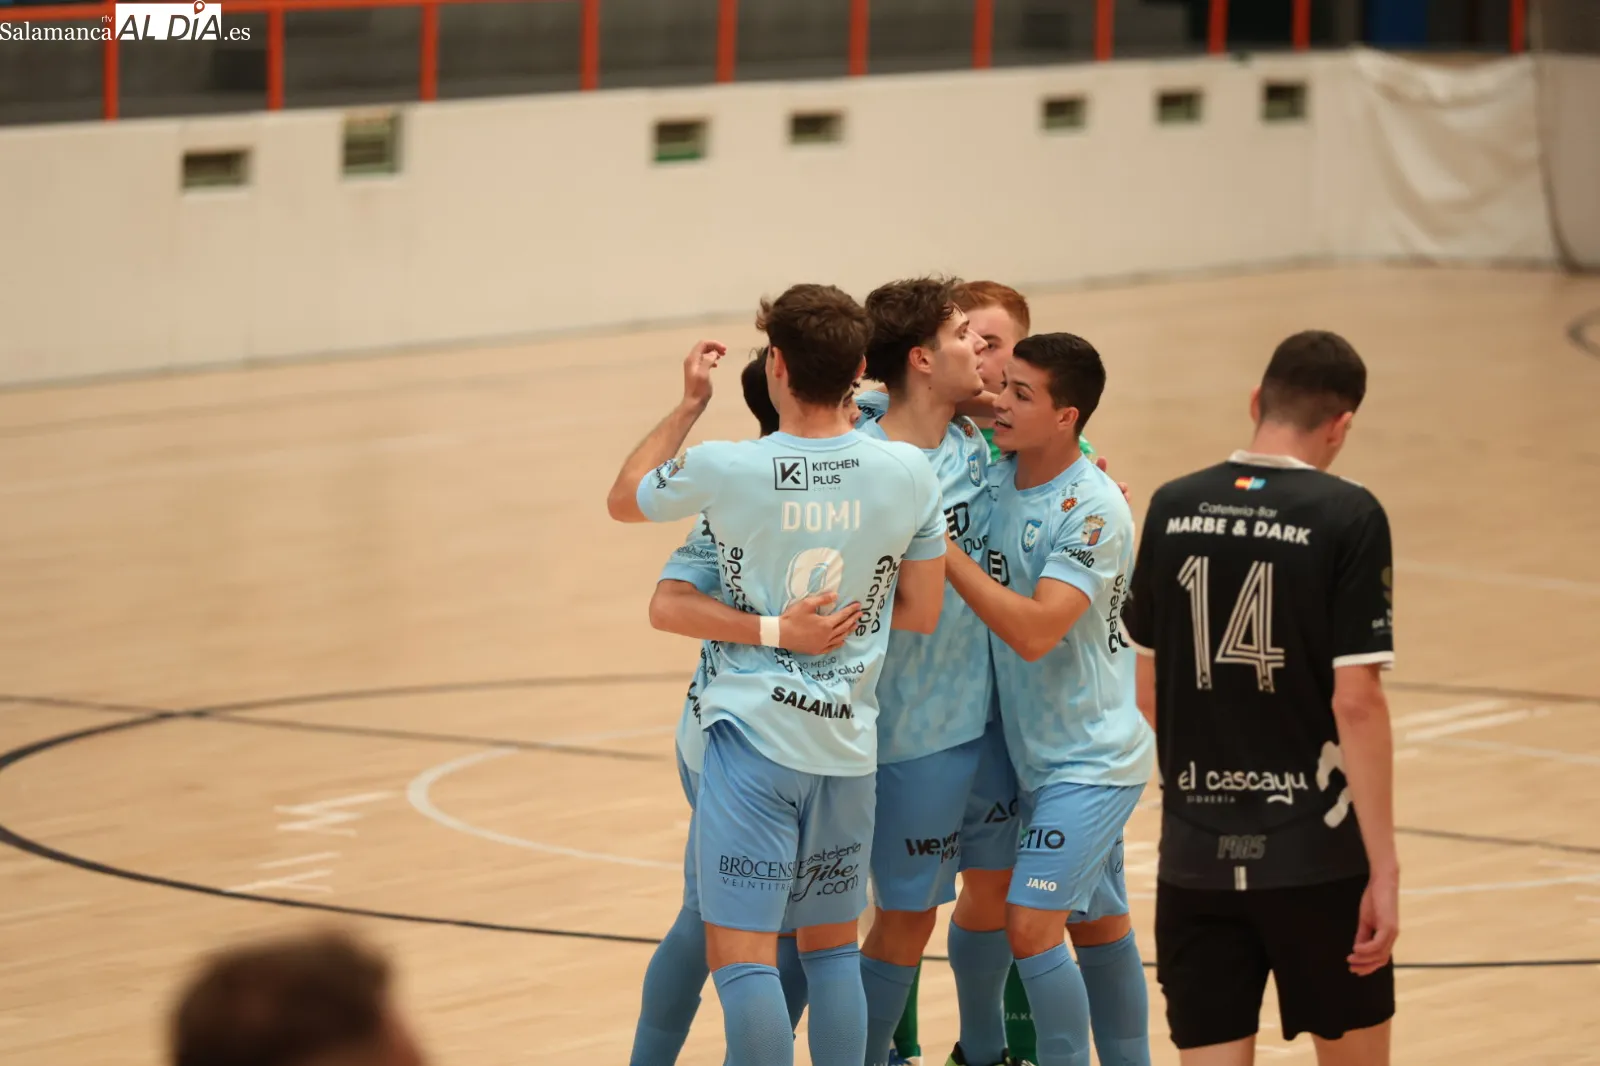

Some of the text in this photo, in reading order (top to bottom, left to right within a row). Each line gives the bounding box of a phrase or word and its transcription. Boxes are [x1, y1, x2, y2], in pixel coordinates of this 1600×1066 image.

[812, 459, 859, 471] KITCHEN
[813, 475, 841, 484] PLUS
[781, 499, 861, 533] DOMI
[1166, 516, 1312, 545] MARBE & DARK
[1106, 574, 1125, 655] Dehesa
[1177, 555, 1285, 693] 14
[771, 686, 855, 719] SALAMAN
[1206, 770, 1309, 805] cascayu
[816, 875, 859, 896] .com
[1026, 877, 1057, 892] JAKO
[1005, 1012, 1034, 1021] JAK
